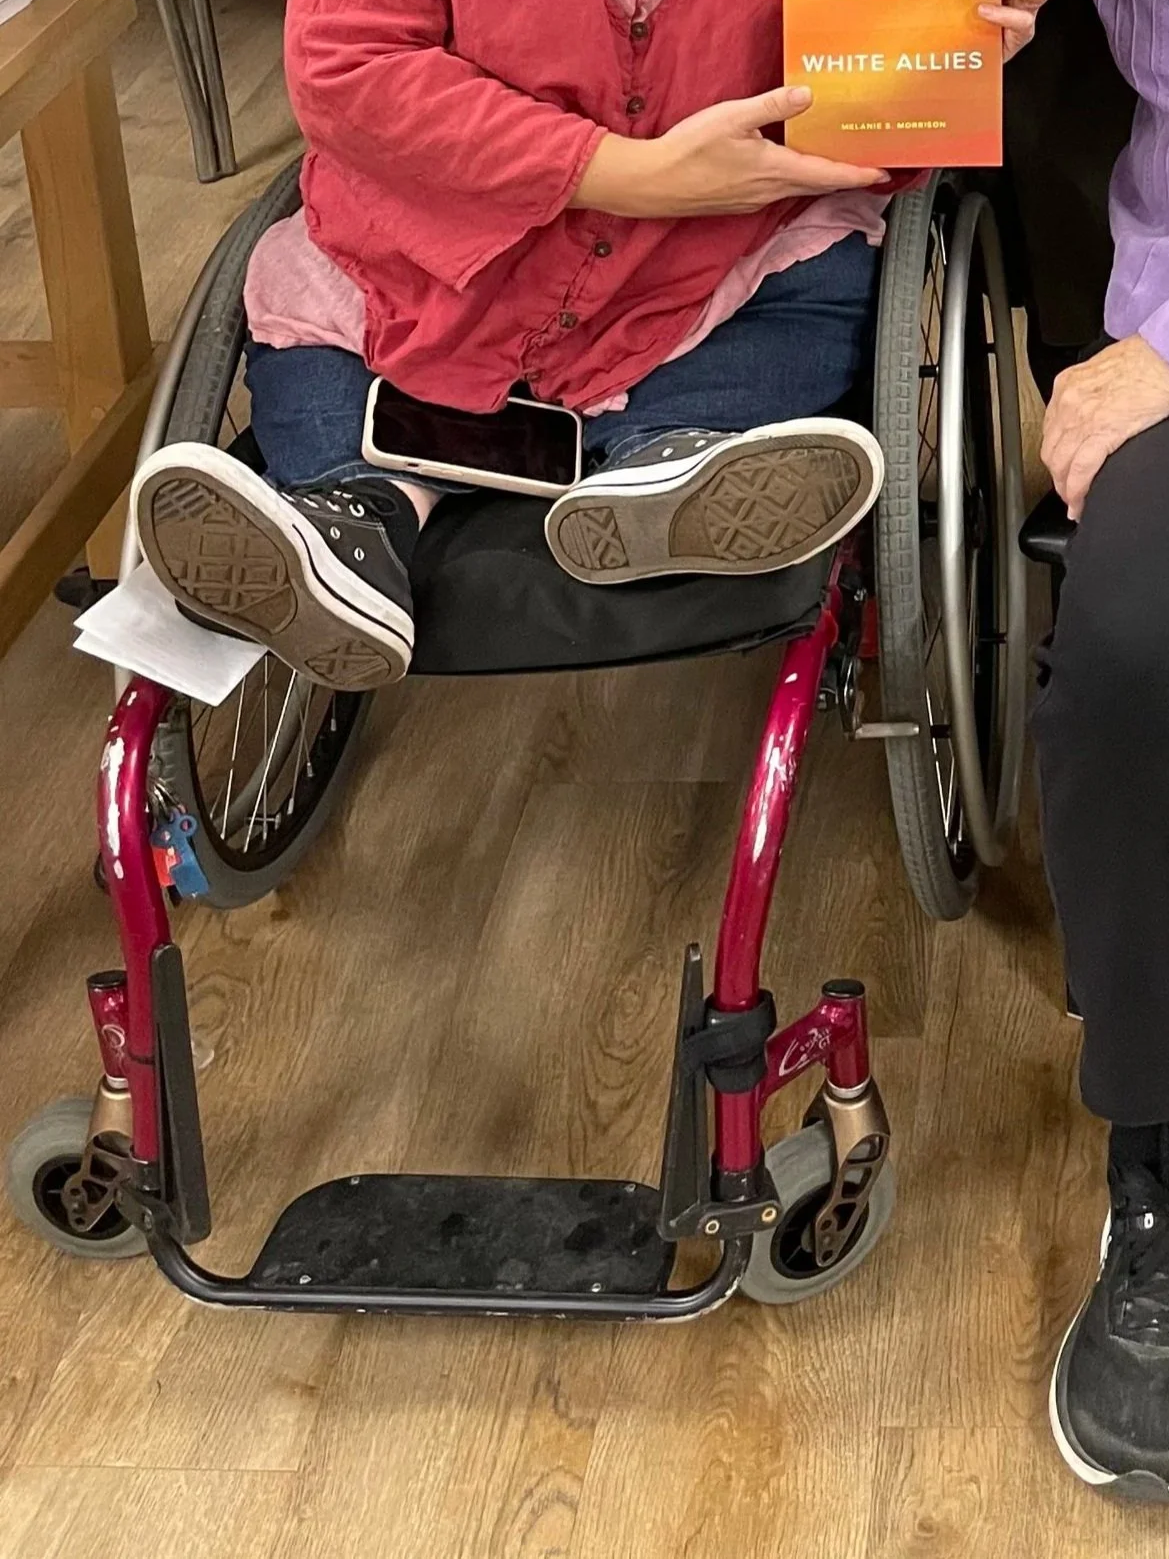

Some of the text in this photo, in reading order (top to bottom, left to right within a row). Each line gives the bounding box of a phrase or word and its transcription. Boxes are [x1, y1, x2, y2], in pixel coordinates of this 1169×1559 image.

[802, 51, 983, 73] WHITE ALLIES
[841, 122, 882, 130] MELANIE
[896, 121, 946, 129] MORRISON
